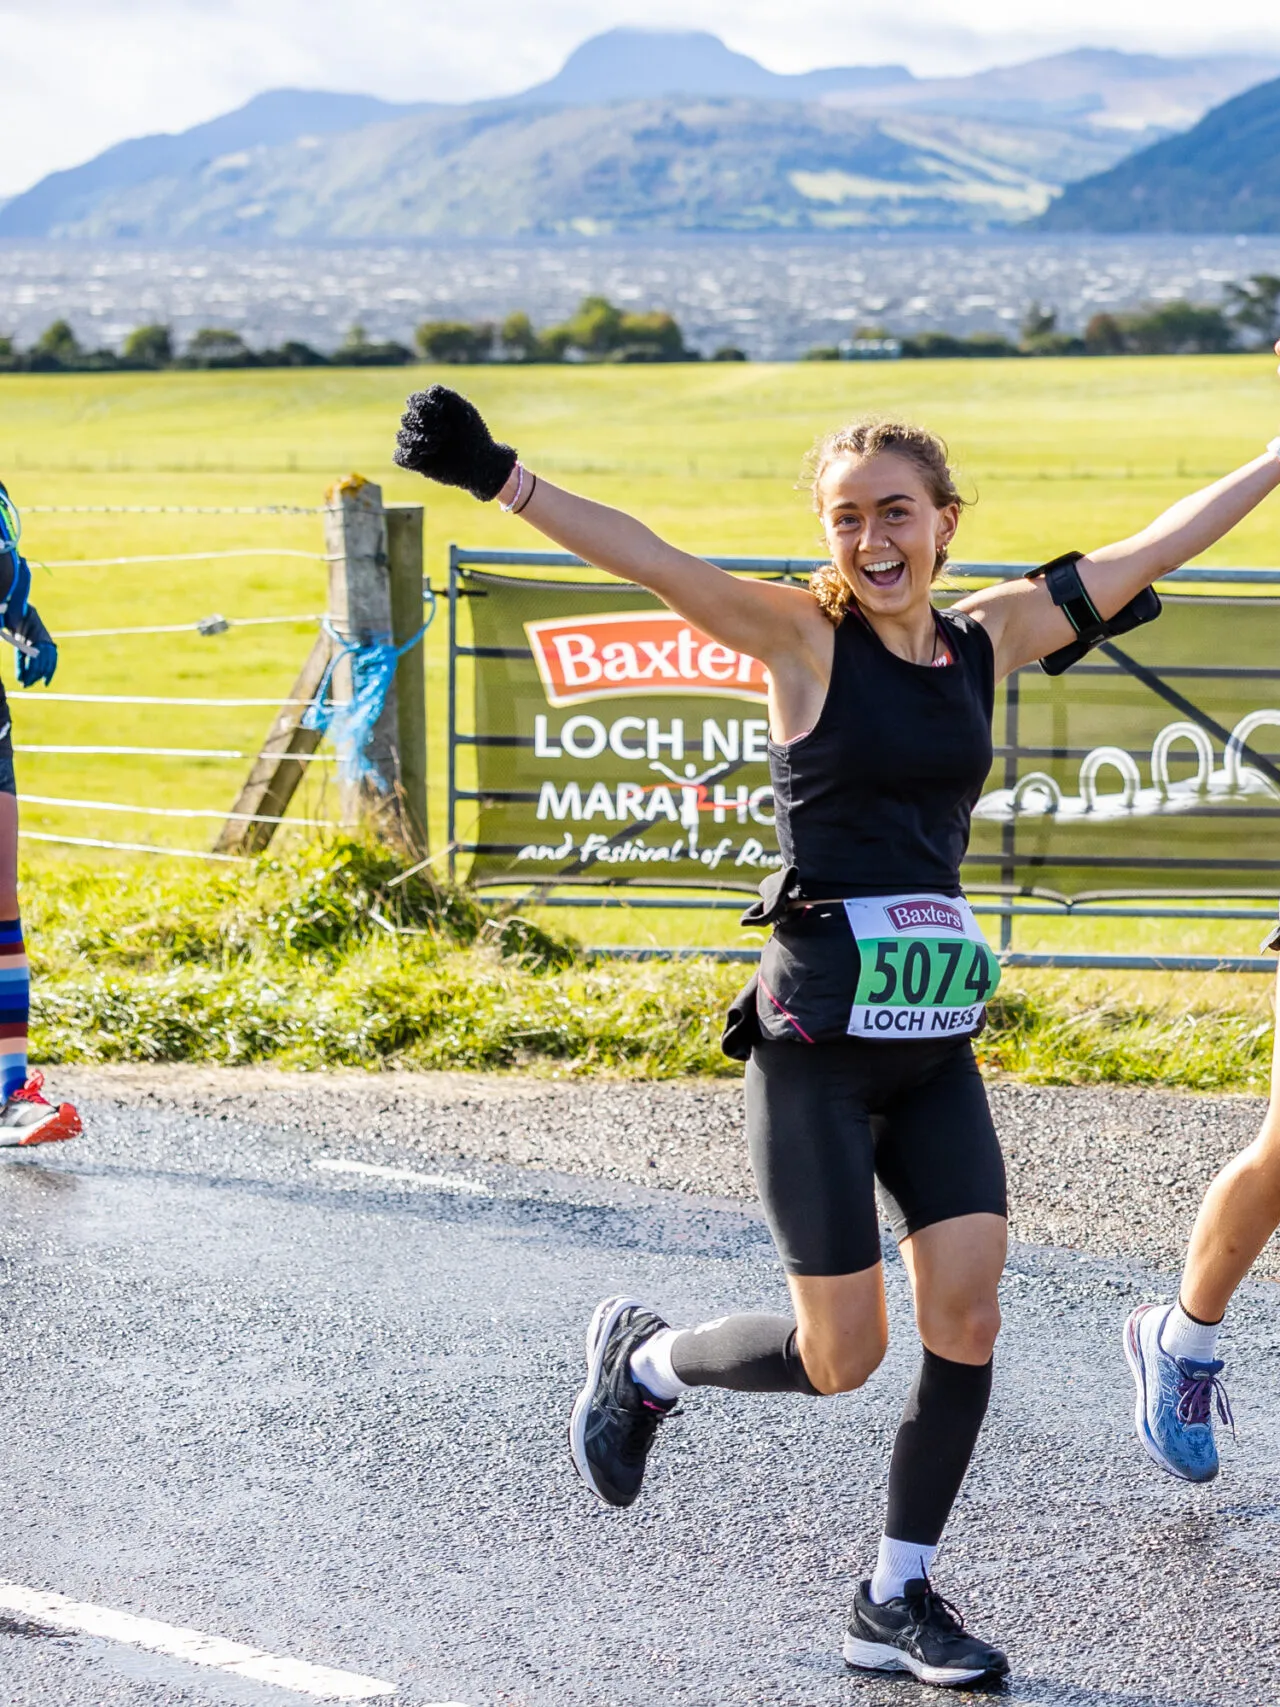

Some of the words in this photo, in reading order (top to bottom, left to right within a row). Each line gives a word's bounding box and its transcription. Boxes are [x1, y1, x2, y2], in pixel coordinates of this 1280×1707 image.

[552, 628, 770, 687] Baxter
[534, 714, 684, 760] LOCH
[702, 718, 769, 762] NE
[536, 780, 777, 827] MARATHO
[517, 831, 573, 862] and
[580, 833, 684, 863] Festival
[700, 838, 732, 869] of
[893, 905, 961, 928] Baxters
[867, 941, 992, 1005] 5074
[863, 1009, 925, 1032] LOCH
[931, 1006, 977, 1031] NESS
